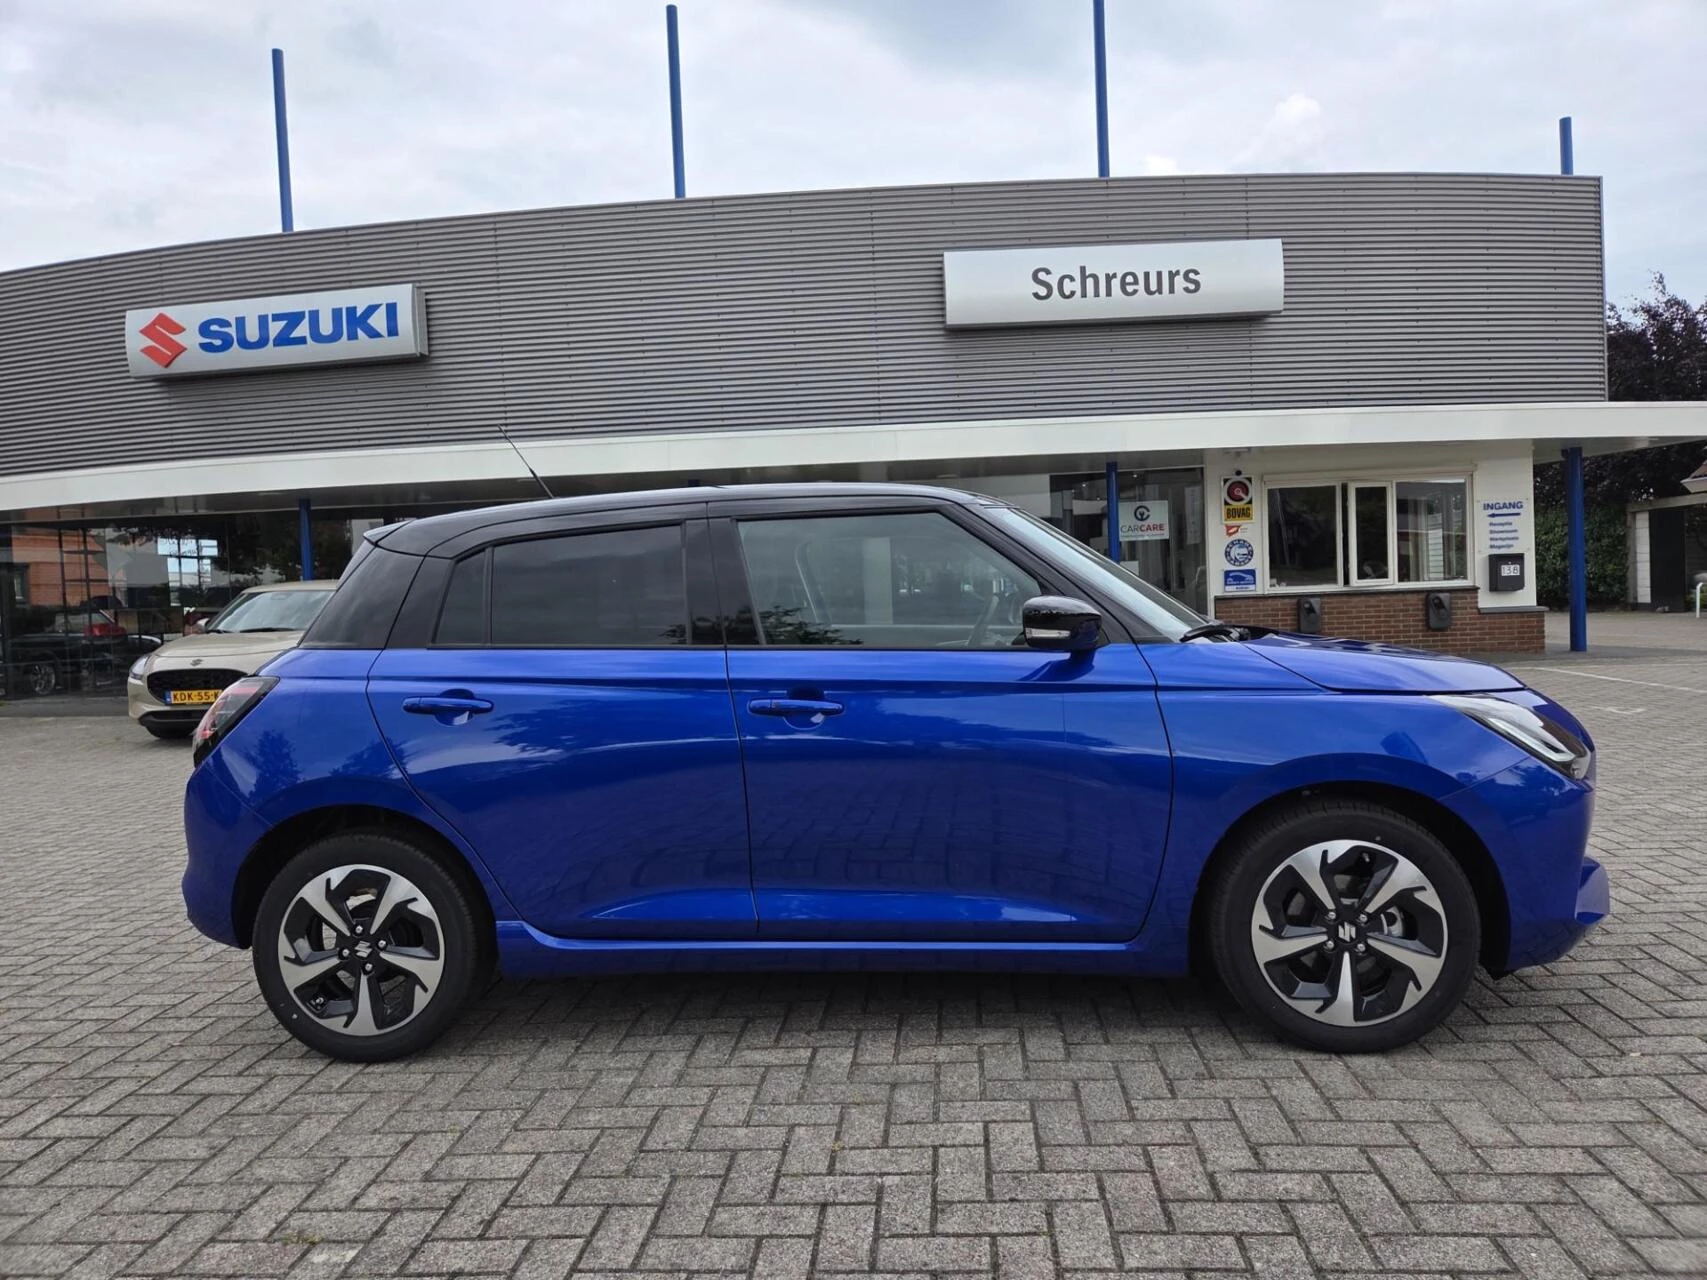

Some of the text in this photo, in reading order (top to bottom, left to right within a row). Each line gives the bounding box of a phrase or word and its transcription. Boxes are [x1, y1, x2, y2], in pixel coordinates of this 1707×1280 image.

[1031, 265, 1202, 301] Schreurs
[197, 302, 399, 353] SUZUKI
[1483, 501, 1523, 510] INGANG
[1226, 507, 1251, 519] BOVAG
[1502, 565, 1519, 575] 138
